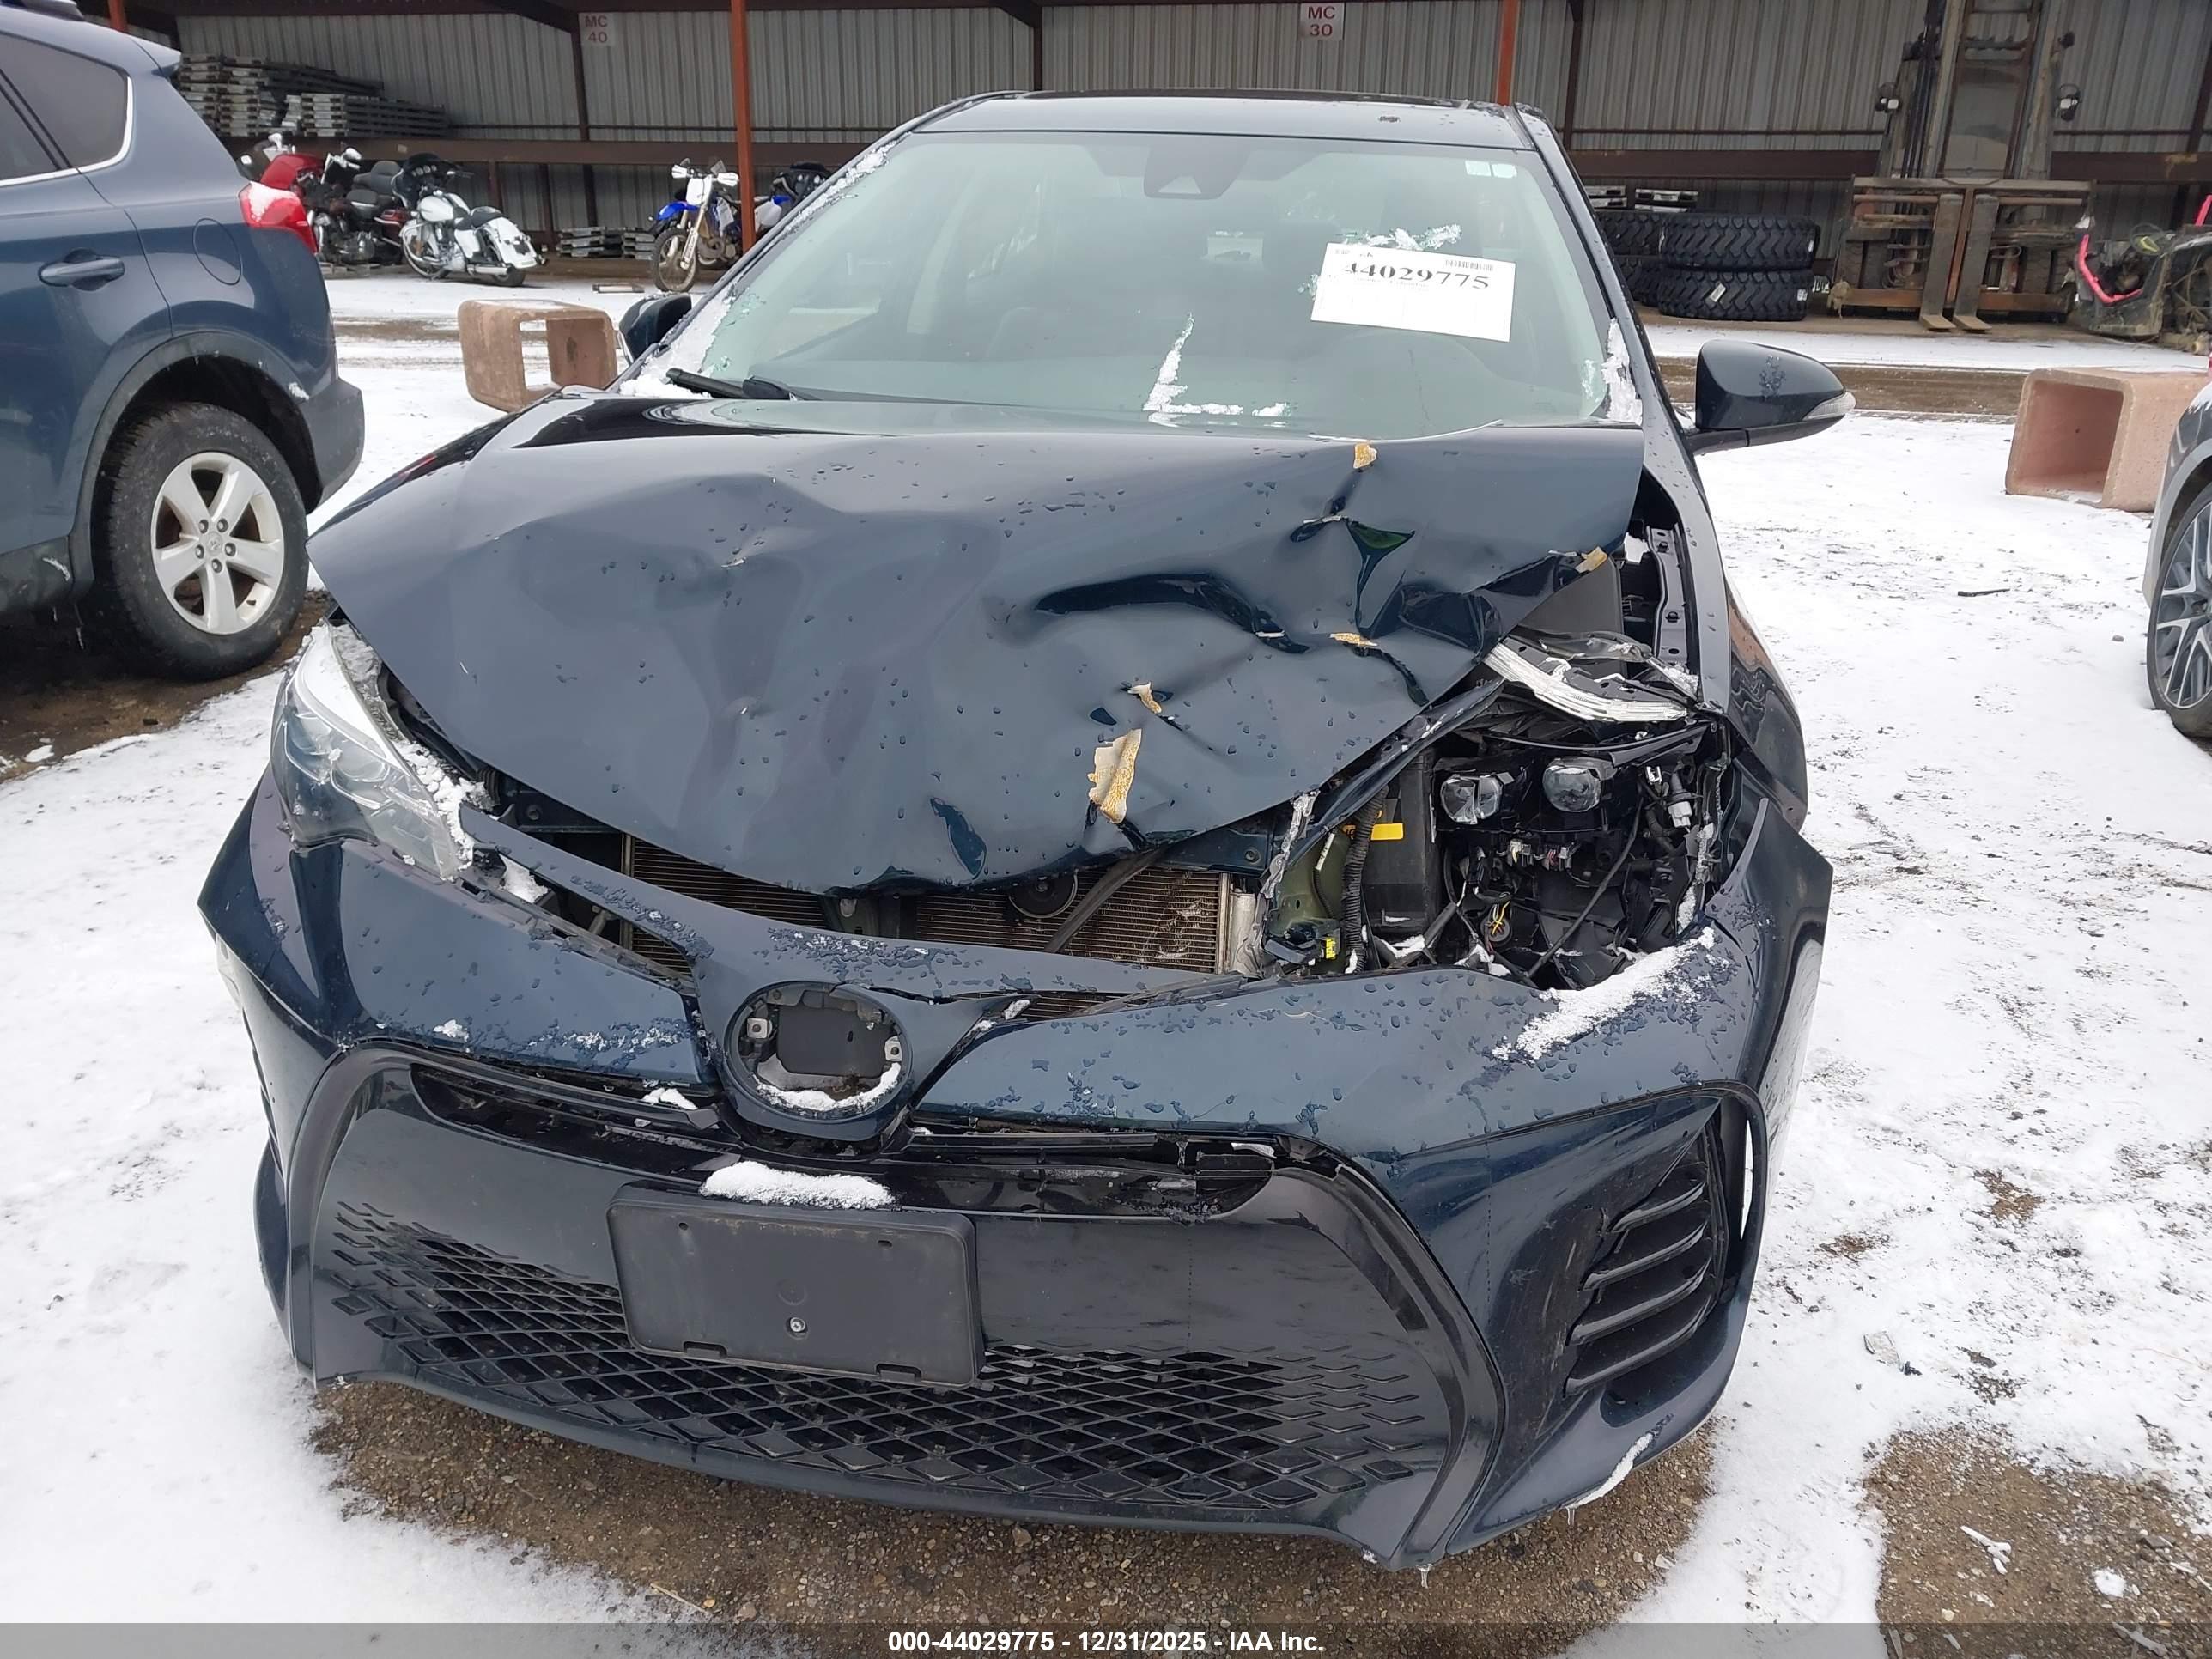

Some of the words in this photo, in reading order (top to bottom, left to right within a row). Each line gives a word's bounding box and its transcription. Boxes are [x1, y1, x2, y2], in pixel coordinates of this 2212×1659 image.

[1308, 6, 1335, 19] MC
[585, 15, 608, 27] MC
[1310, 24, 1333, 36] 30
[588, 32, 608, 43] 40
